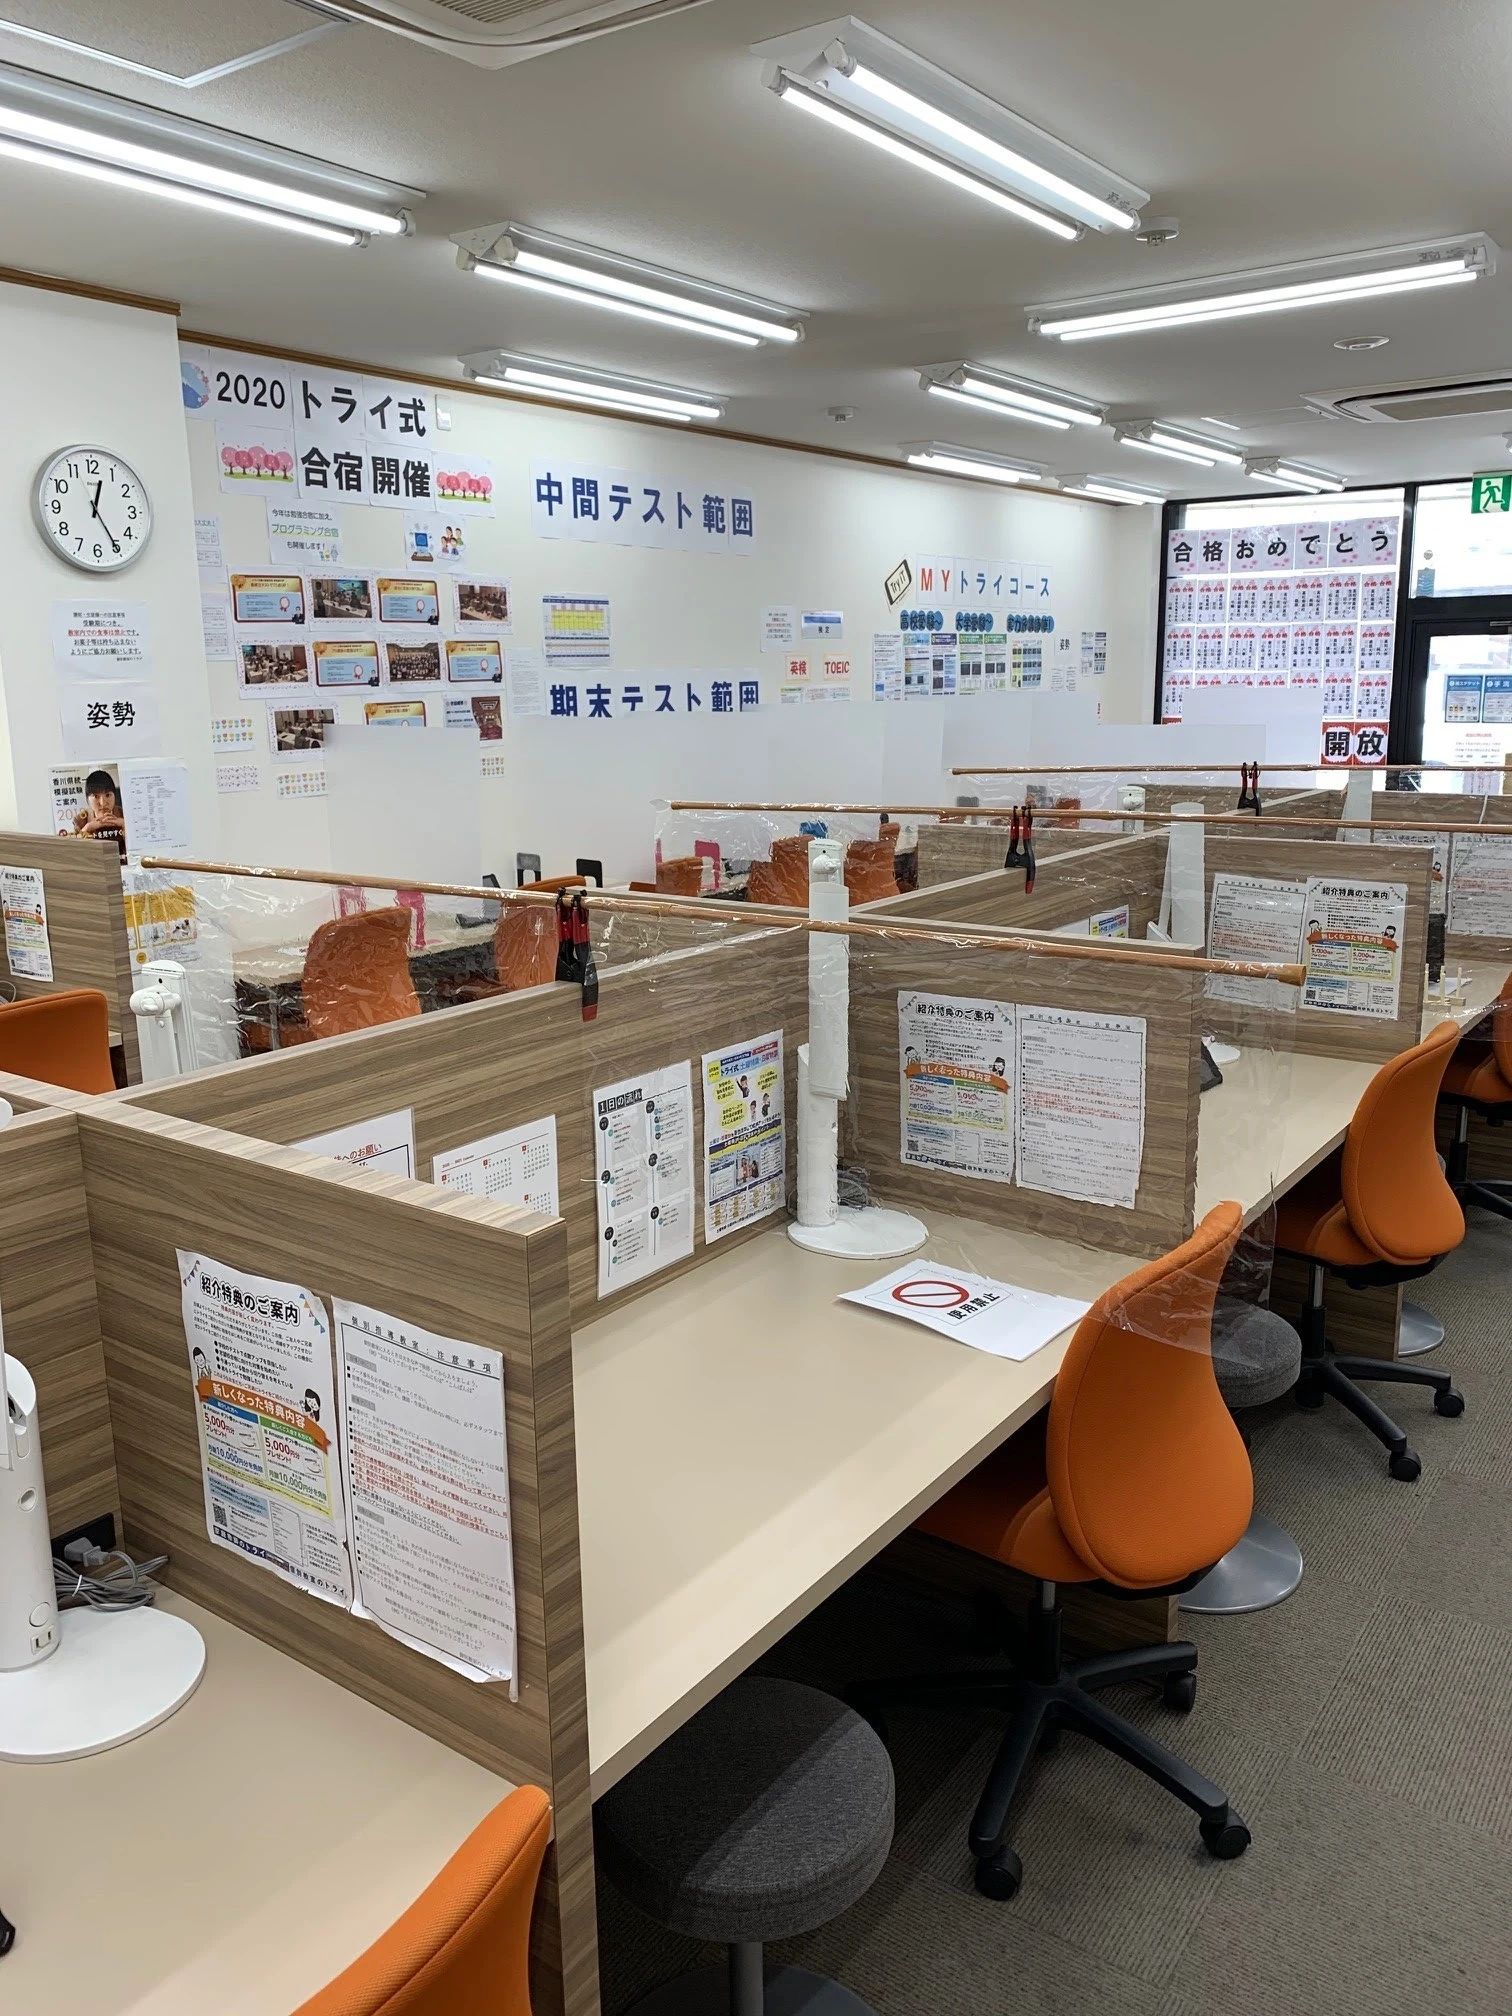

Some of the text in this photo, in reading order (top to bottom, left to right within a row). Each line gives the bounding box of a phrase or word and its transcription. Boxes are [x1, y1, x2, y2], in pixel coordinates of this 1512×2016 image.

[68, 463, 79, 478] 11
[86, 459, 100, 474] 12
[301, 447, 431, 497] 合宿開催
[110, 468, 115, 482] 1
[54, 479, 68, 493] 10
[121, 484, 131, 498] 2
[51, 500, 61, 514] 9
[536, 472, 753, 537] 中間テスト範囲
[127, 506, 137, 519] 3
[59, 522, 69, 535] 8
[123, 527, 133, 539] 4
[272, 523, 339, 537] プログラミング合宿
[75, 538, 84, 551] 7
[93, 544, 103, 558] 6
[112, 540, 121, 553] 5
[1173, 531, 1389, 563] 合格おめでとう
[790, 661, 807, 675] 英検
[824, 661, 850, 674] TOEIC
[550, 681, 759, 718] 期末テスト範囲
[87, 700, 136, 729] 姿勢
[1325, 730, 1384, 757] 開放
[56, 798, 78, 806] ご案内
[1321, 886, 1390, 900] 紹介特典のご案内
[916, 1003, 995, 1022] 紹介特典のご案内
[201, 1274, 299, 1325] 紹介特典のご案内
[947, 1292, 1000, 1320] 使用禁止
[212, 1380, 305, 1429] 新しくなった特典内容
